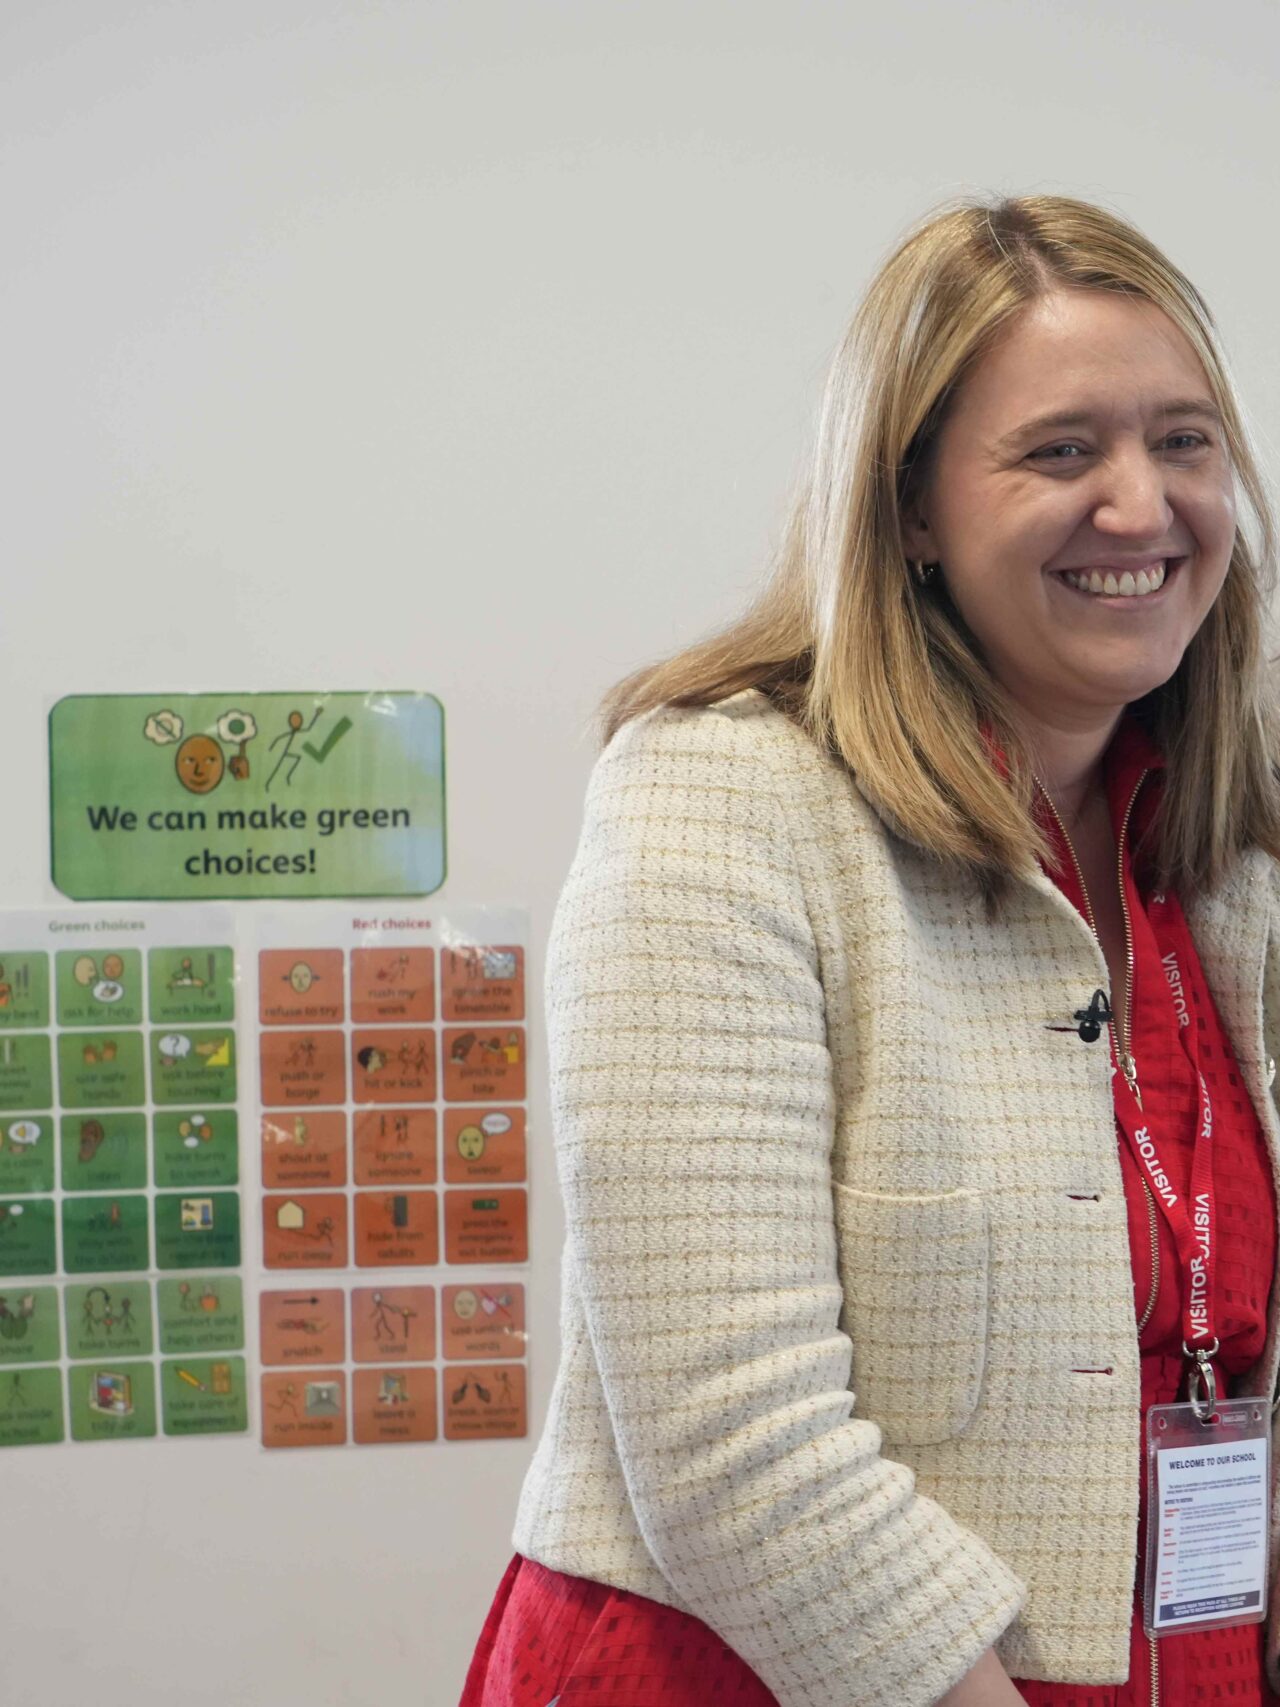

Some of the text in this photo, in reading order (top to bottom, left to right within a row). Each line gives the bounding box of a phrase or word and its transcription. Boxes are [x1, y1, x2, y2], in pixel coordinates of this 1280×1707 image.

[87, 803, 411, 836] We can make green
[184, 849, 316, 876] choices!
[48, 918, 146, 933] Green choices
[352, 917, 432, 930] Red choices
[1161, 951, 1190, 1030] VISITOR
[1199, 1072, 1212, 1138] ITOR
[1134, 1126, 1178, 1208] VISITOR
[1195, 1193, 1210, 1262] VISIT
[1190, 1256, 1209, 1340] VISITOR
[1169, 1452, 1256, 1470] WELCOME TO OUR SCHOOL
